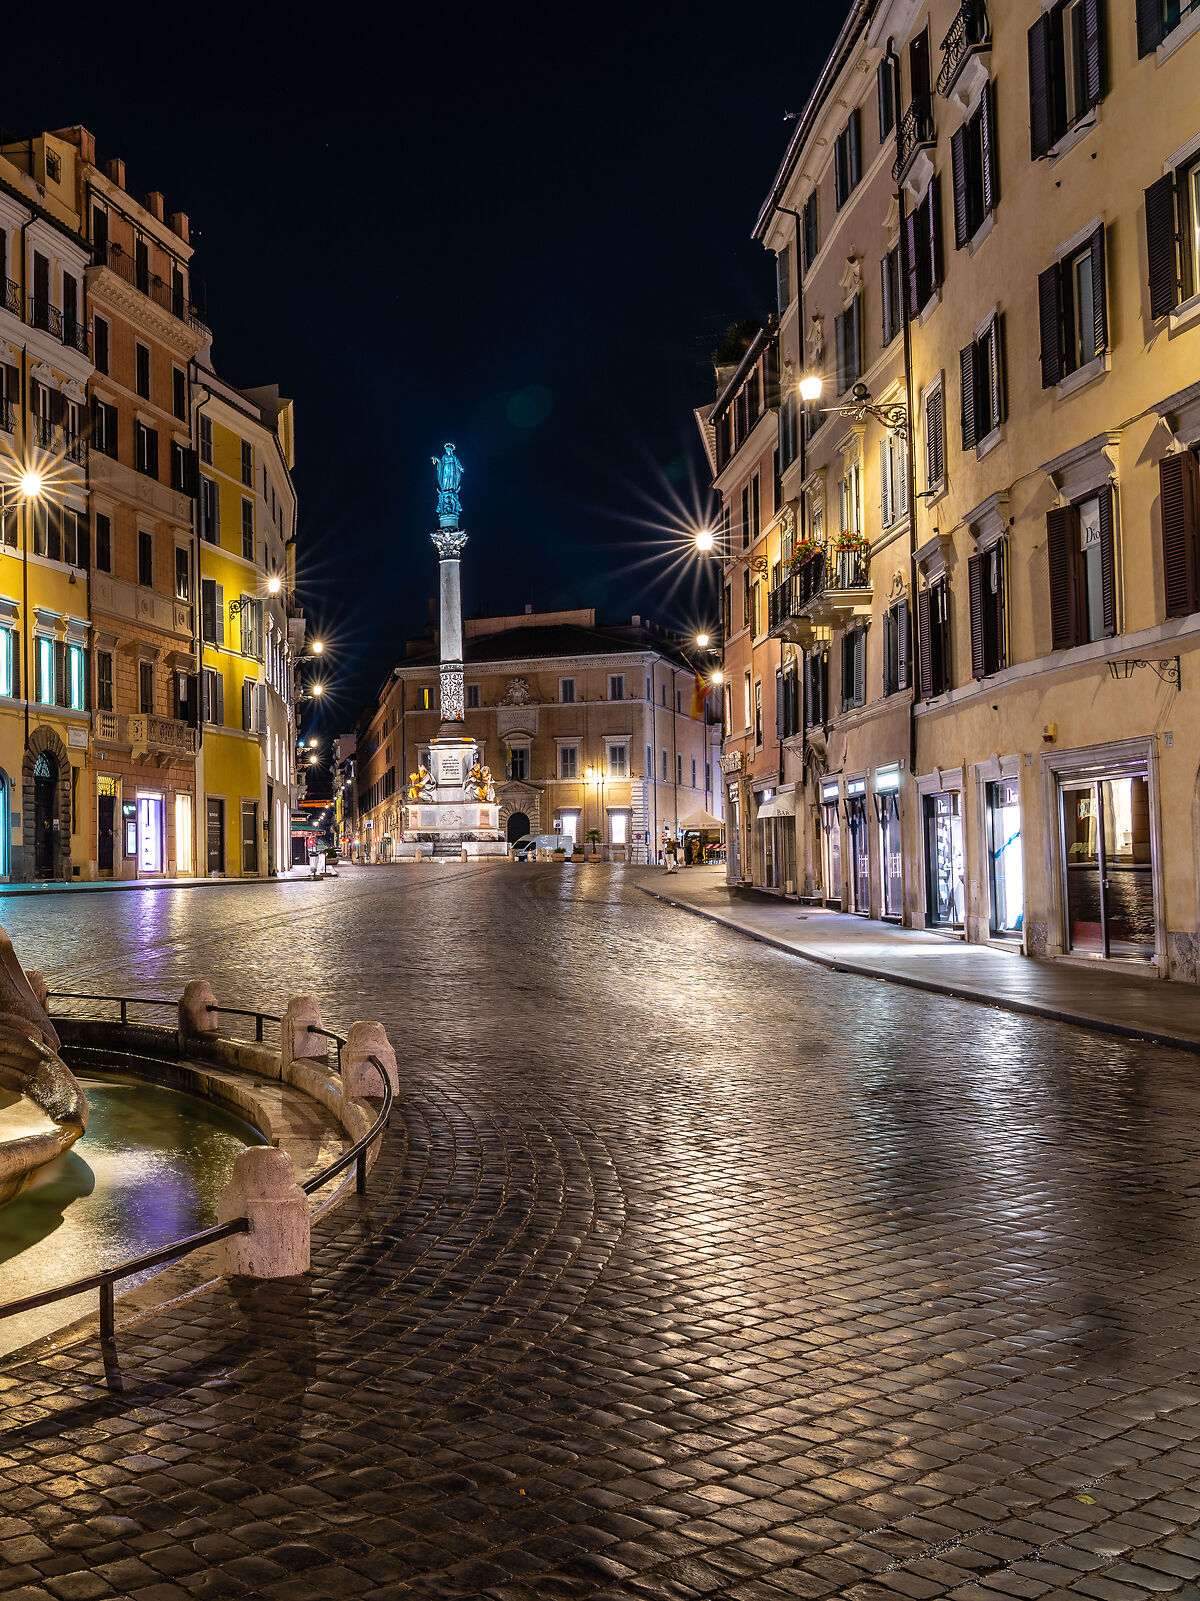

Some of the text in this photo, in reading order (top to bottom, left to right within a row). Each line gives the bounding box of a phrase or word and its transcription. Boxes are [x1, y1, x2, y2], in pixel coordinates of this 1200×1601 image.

[1086, 527, 1101, 544] Dio
[1006, 787, 1020, 804] Dior
[776, 808, 790, 816] BAR
[937, 799, 948, 814] Dior
